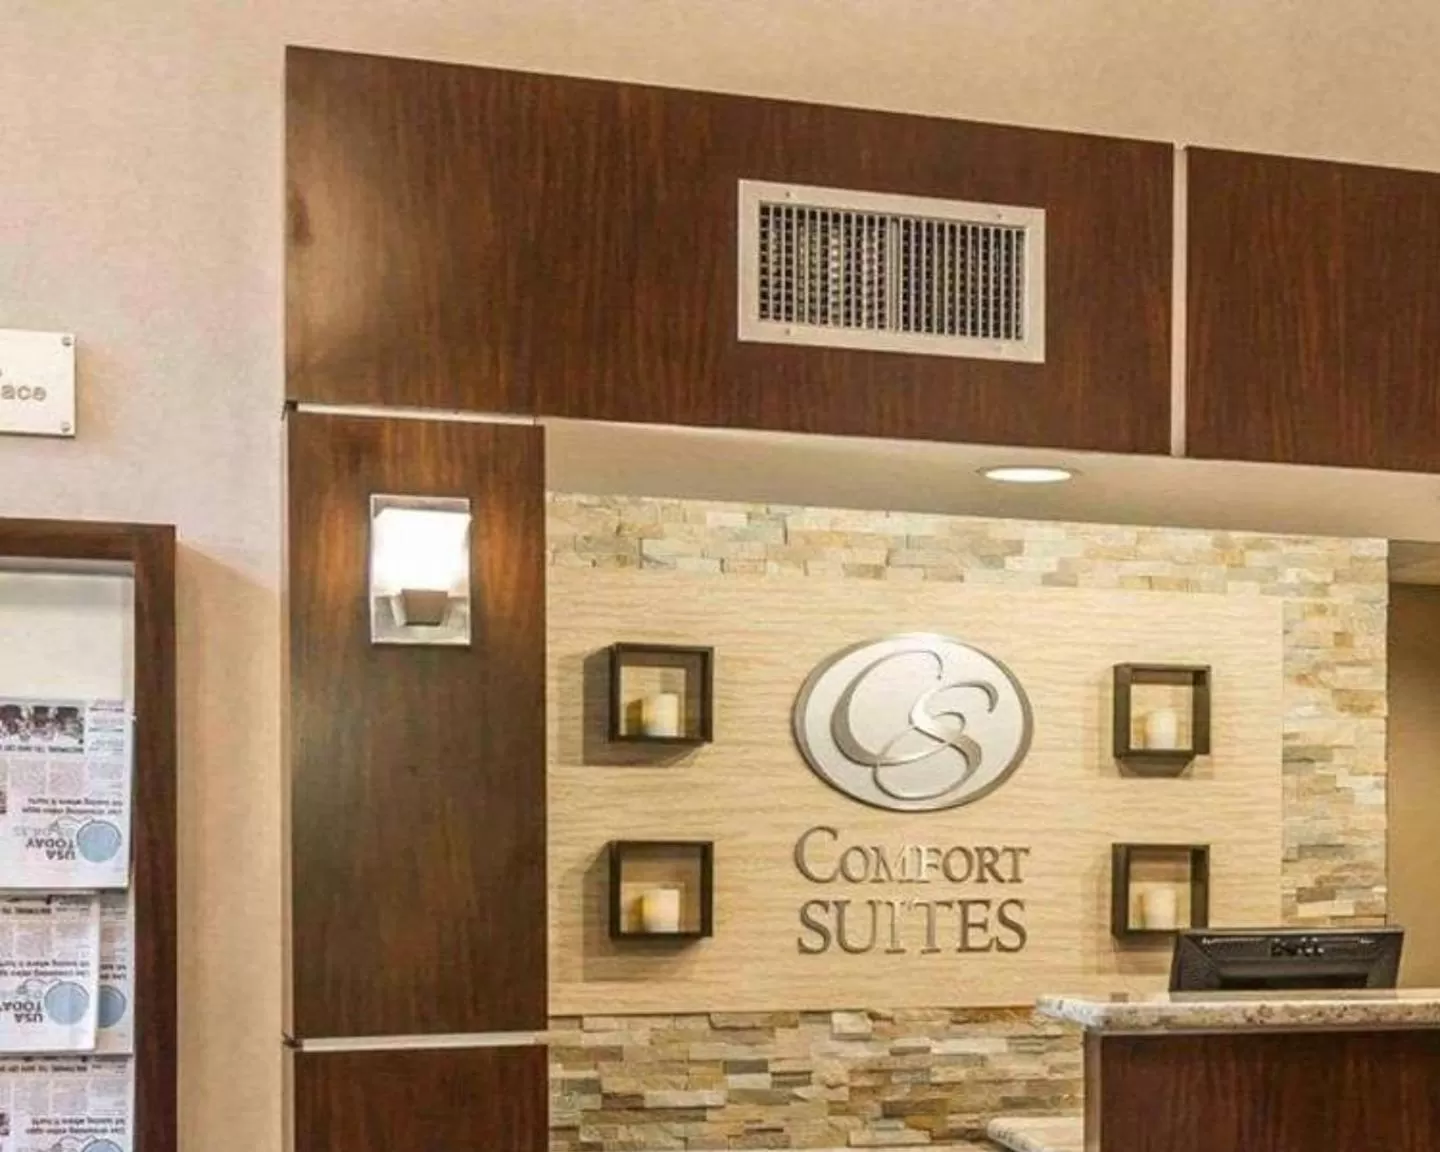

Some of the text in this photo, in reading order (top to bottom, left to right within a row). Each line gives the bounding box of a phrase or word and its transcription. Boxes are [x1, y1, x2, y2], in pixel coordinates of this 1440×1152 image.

[26, 838, 74, 849] TODAY
[46, 850, 76, 860] USA
[794, 826, 1031, 884] COMFORT
[797, 898, 1028, 955] SUITES
[15, 1013, 43, 1023] USA
